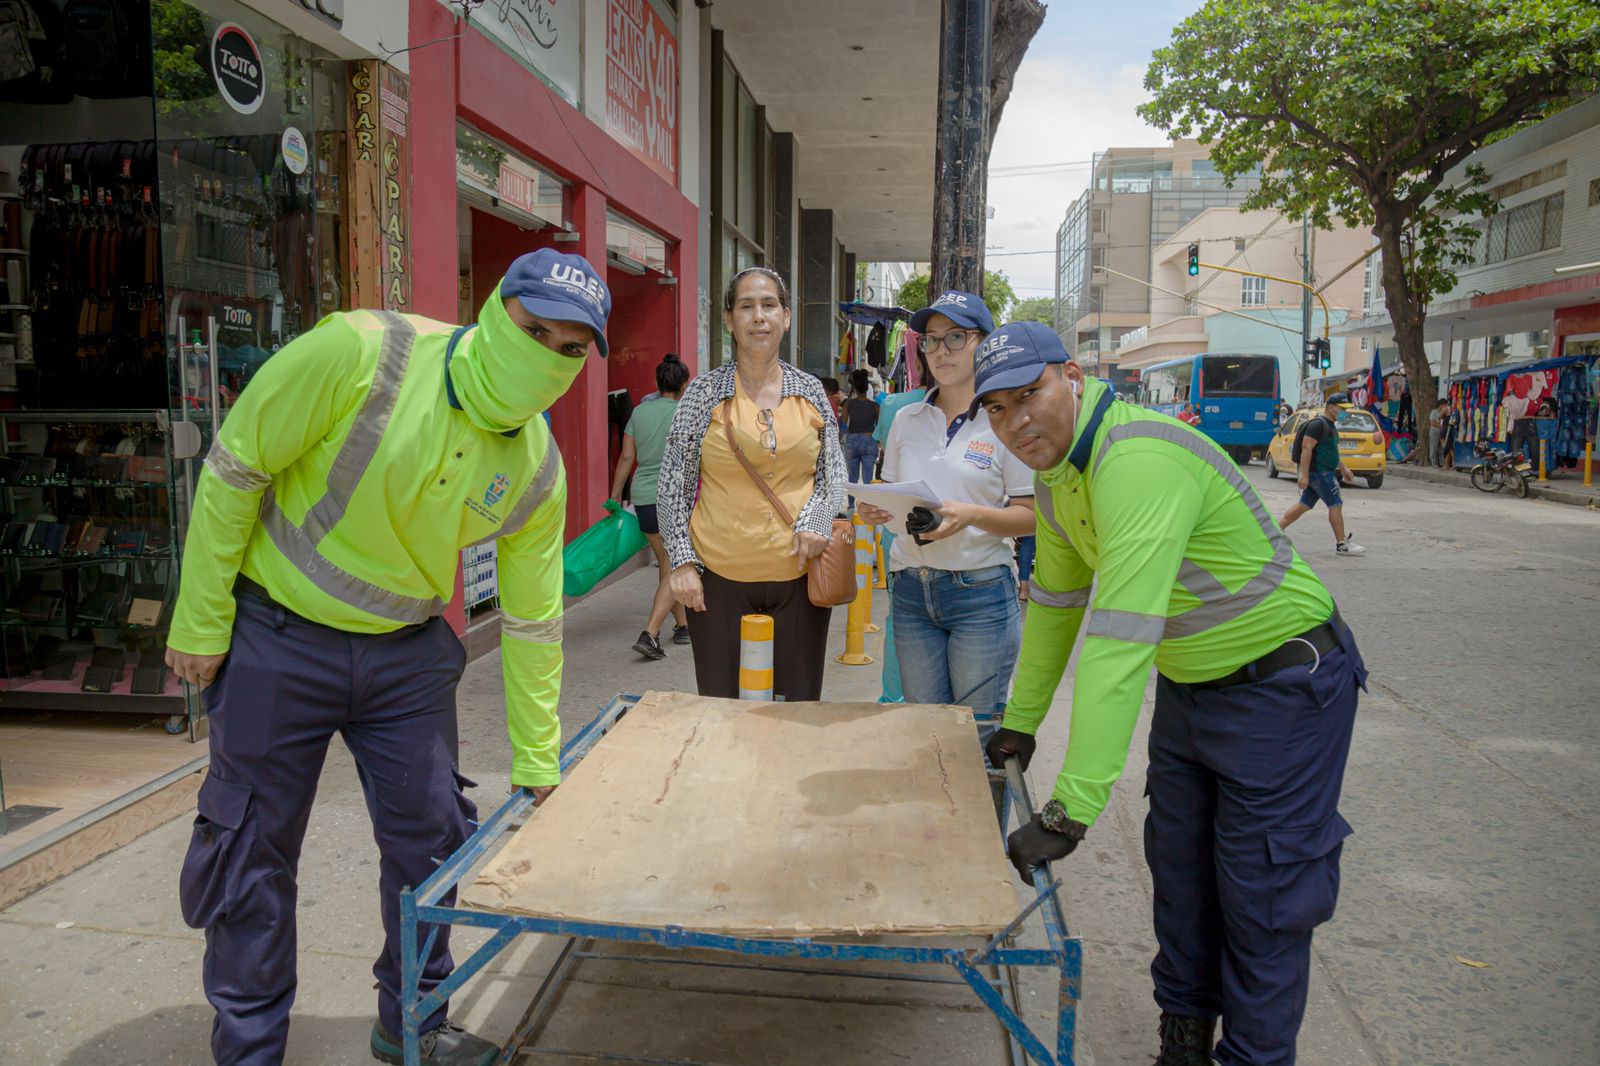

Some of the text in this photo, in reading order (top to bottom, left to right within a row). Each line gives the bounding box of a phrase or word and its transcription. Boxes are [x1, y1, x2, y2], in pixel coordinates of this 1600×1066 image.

[220, 48, 258, 79] TOTTO
[605, 0, 645, 92] JEANS
[605, 95, 643, 153] ABALLERO
[657, 122, 674, 173] MIL
[551, 263, 605, 301] UDEP
[938, 293, 967, 303] DEP
[223, 305, 252, 326] TOTTO
